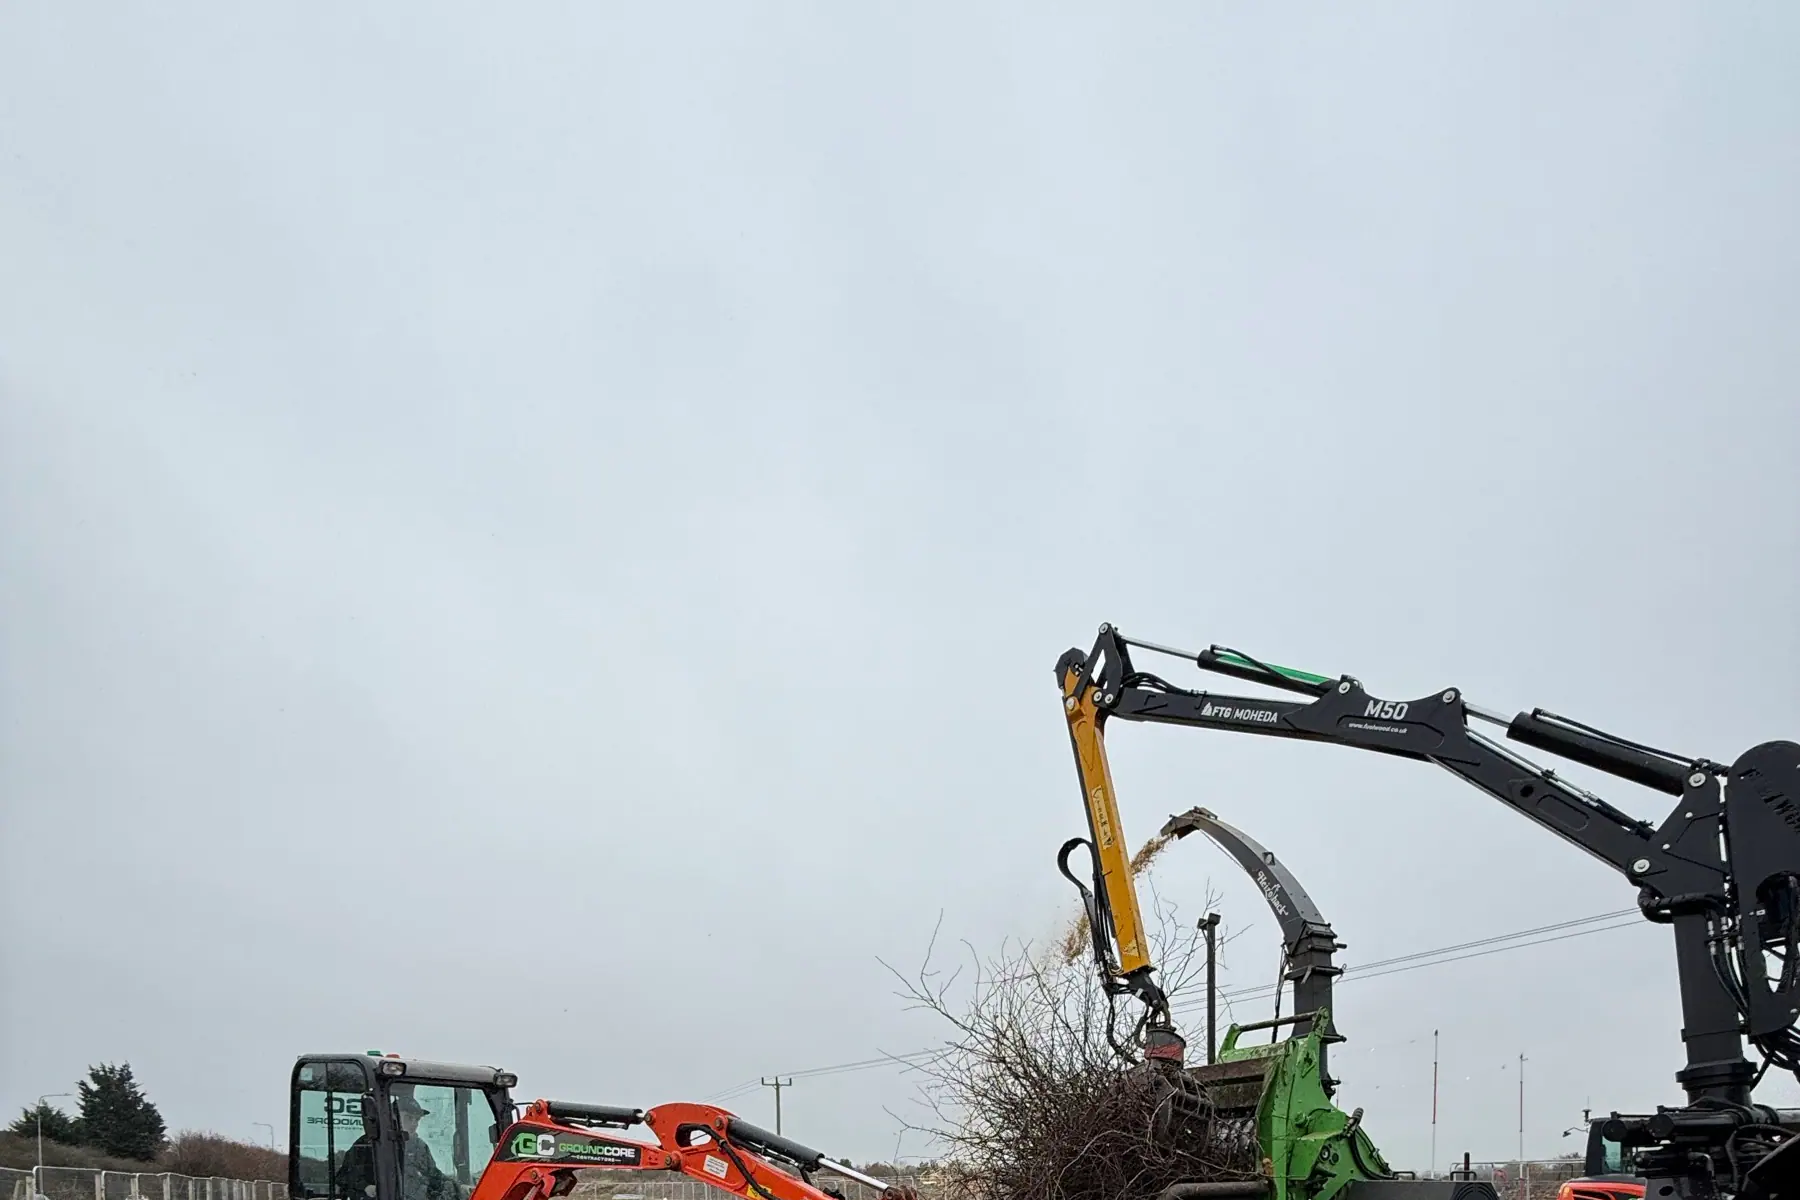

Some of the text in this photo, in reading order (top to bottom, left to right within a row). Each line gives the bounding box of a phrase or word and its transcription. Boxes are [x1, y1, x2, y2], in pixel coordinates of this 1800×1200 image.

[1212, 706, 1278, 723] FTG MOHEDA
[1364, 700, 1408, 720] M50
[512, 1132, 555, 1157] GC
[558, 1143, 636, 1158] GROUNDCORE
